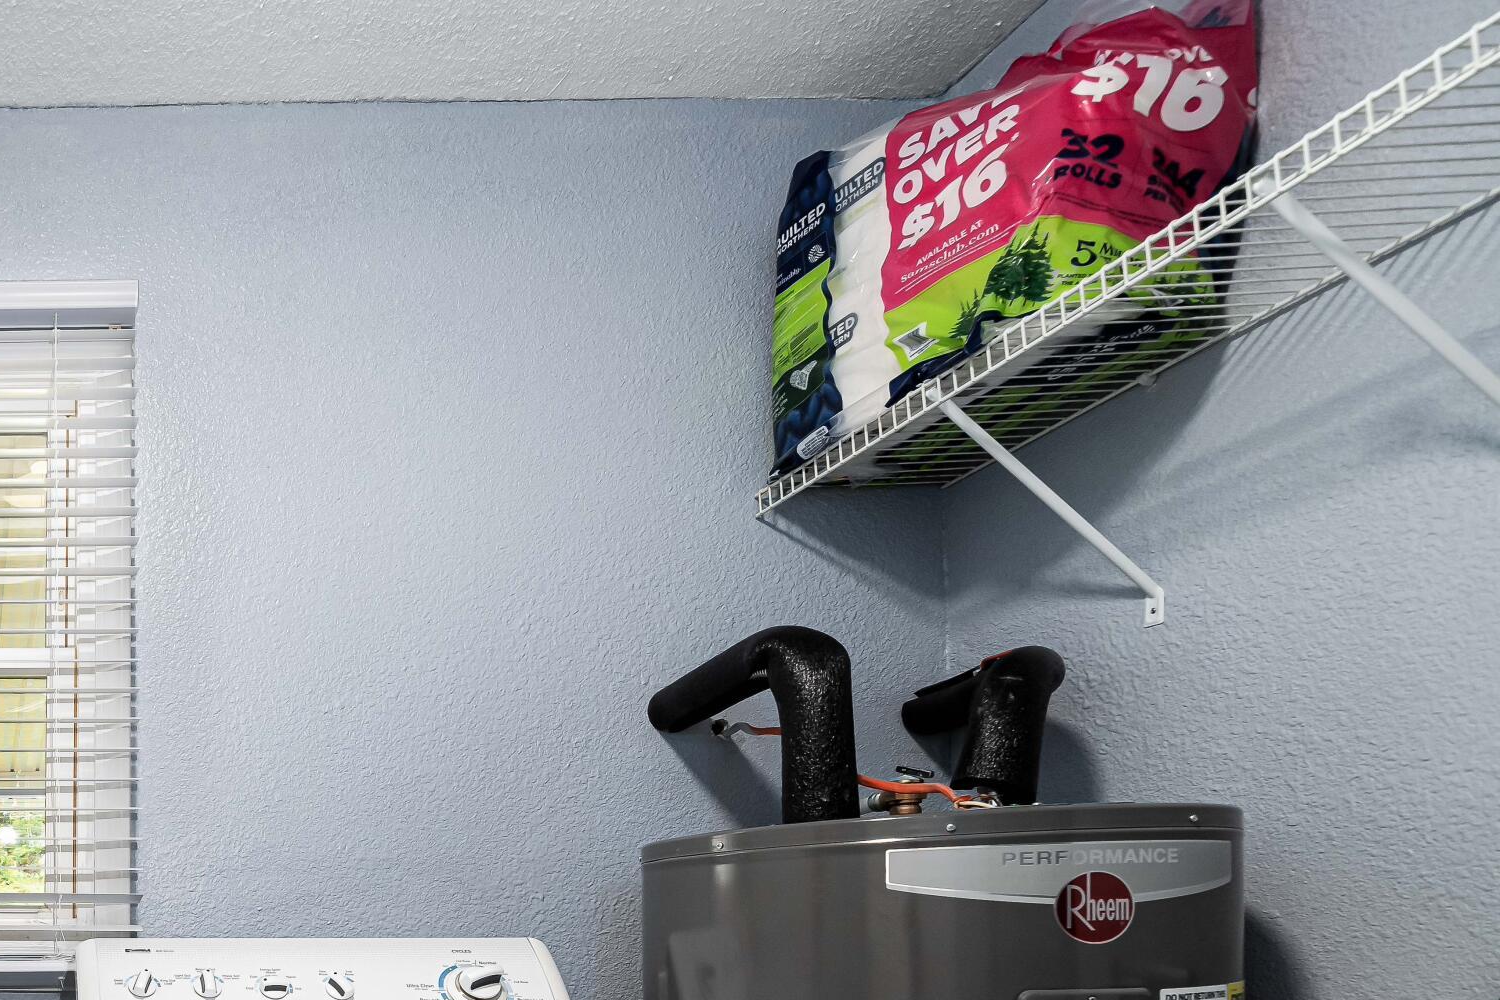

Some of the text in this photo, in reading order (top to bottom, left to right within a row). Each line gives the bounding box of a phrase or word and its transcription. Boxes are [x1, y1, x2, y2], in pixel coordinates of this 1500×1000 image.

[1071, 52, 1228, 132] $16
[893, 105, 1019, 204] OVER
[1056, 128, 1125, 169] 32
[835, 161, 884, 203] UILTED
[836, 177, 879, 212] ORTHERN
[898, 143, 1009, 250] $16
[1054, 163, 1123, 189] ROLLS
[916, 219, 984, 267] AVAILABLE AT
[1071, 240, 1097, 267] 5
[1002, 848, 1180, 866] PERFORMANCE
[1066, 872, 1130, 932] Rheem
[1179, 993, 1192, 1000] NOT
